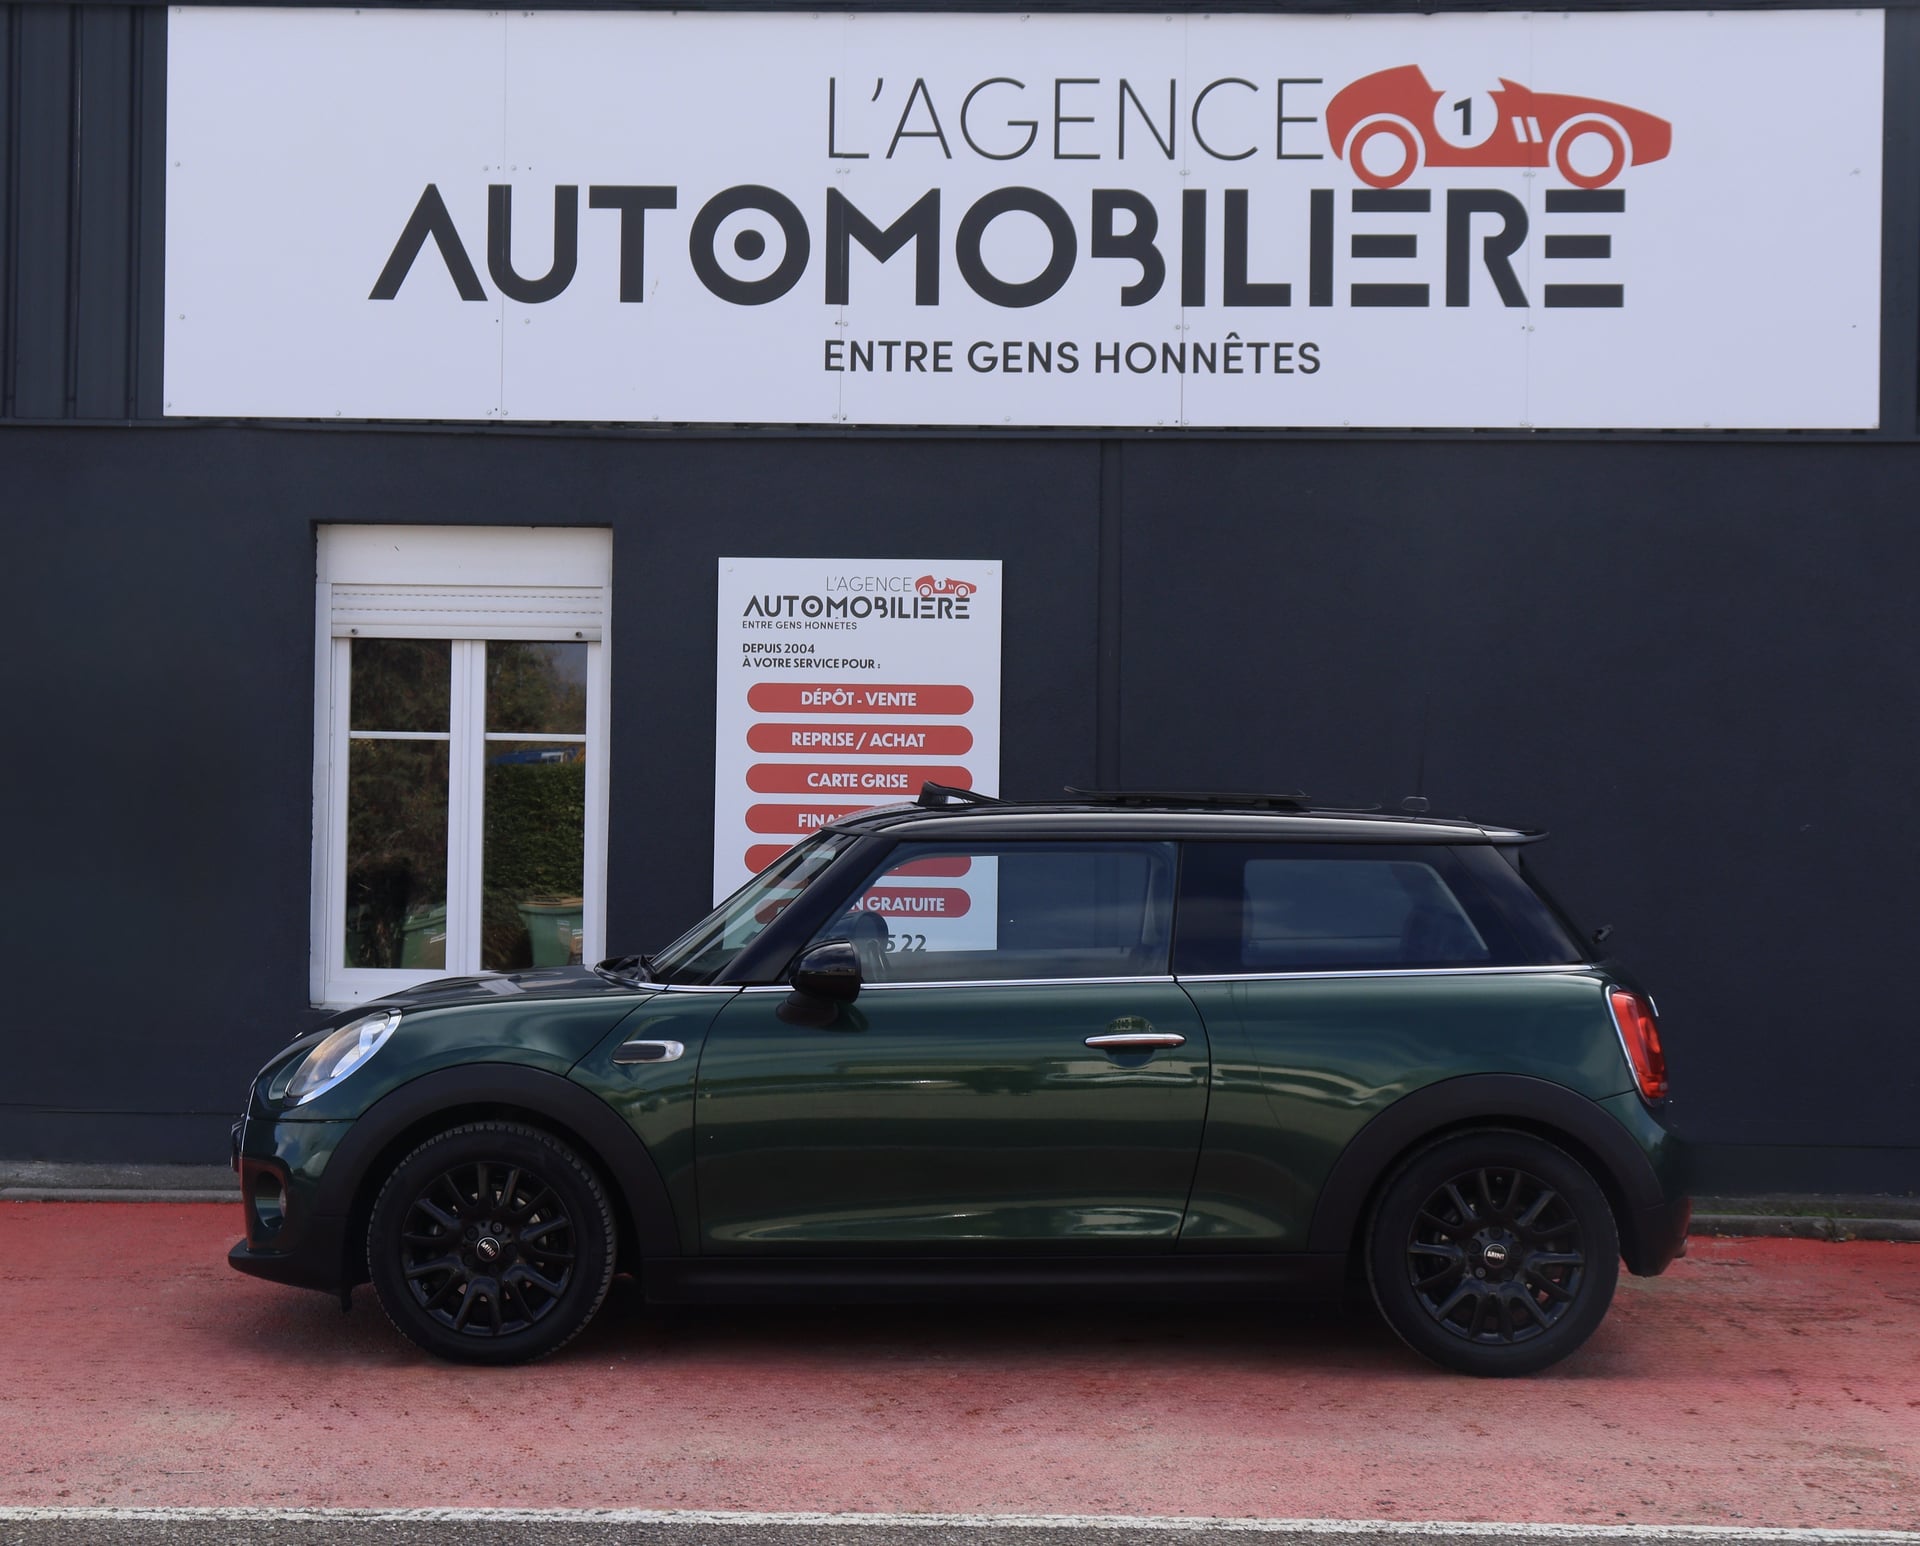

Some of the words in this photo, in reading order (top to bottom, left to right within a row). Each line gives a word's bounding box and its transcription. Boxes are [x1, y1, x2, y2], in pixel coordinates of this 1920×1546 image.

[829, 77, 1323, 161] L'AGENCE
[1454, 98, 1471, 135] 1
[825, 340, 952, 372] ENTRE
[968, 341, 1079, 373] GENS
[1095, 332, 1320, 374] HONNÊTES
[827, 576, 912, 592] L'AGENCE
[743, 621, 772, 629] ENTRE
[776, 621, 801, 629] GENS
[743, 643, 781, 653] DEPUIS
[784, 644, 814, 653] 2004
[743, 655, 751, 667] À
[754, 658, 791, 668] VOTRE
[794, 658, 839, 668] SERVICE
[842, 659, 875, 669] POUR
[802, 688, 854, 705] DÉPÔT
[866, 692, 916, 706] VENTE
[792, 732, 854, 746] REPRISE
[856, 732, 866, 750] /
[870, 733, 925, 747] ACHAT
[808, 773, 858, 787] CARTE
[861, 774, 908, 787] GRISE
[798, 813, 843, 828] FINA
[867, 896, 945, 912] GRATUITE
[901, 934, 926, 952] 22
